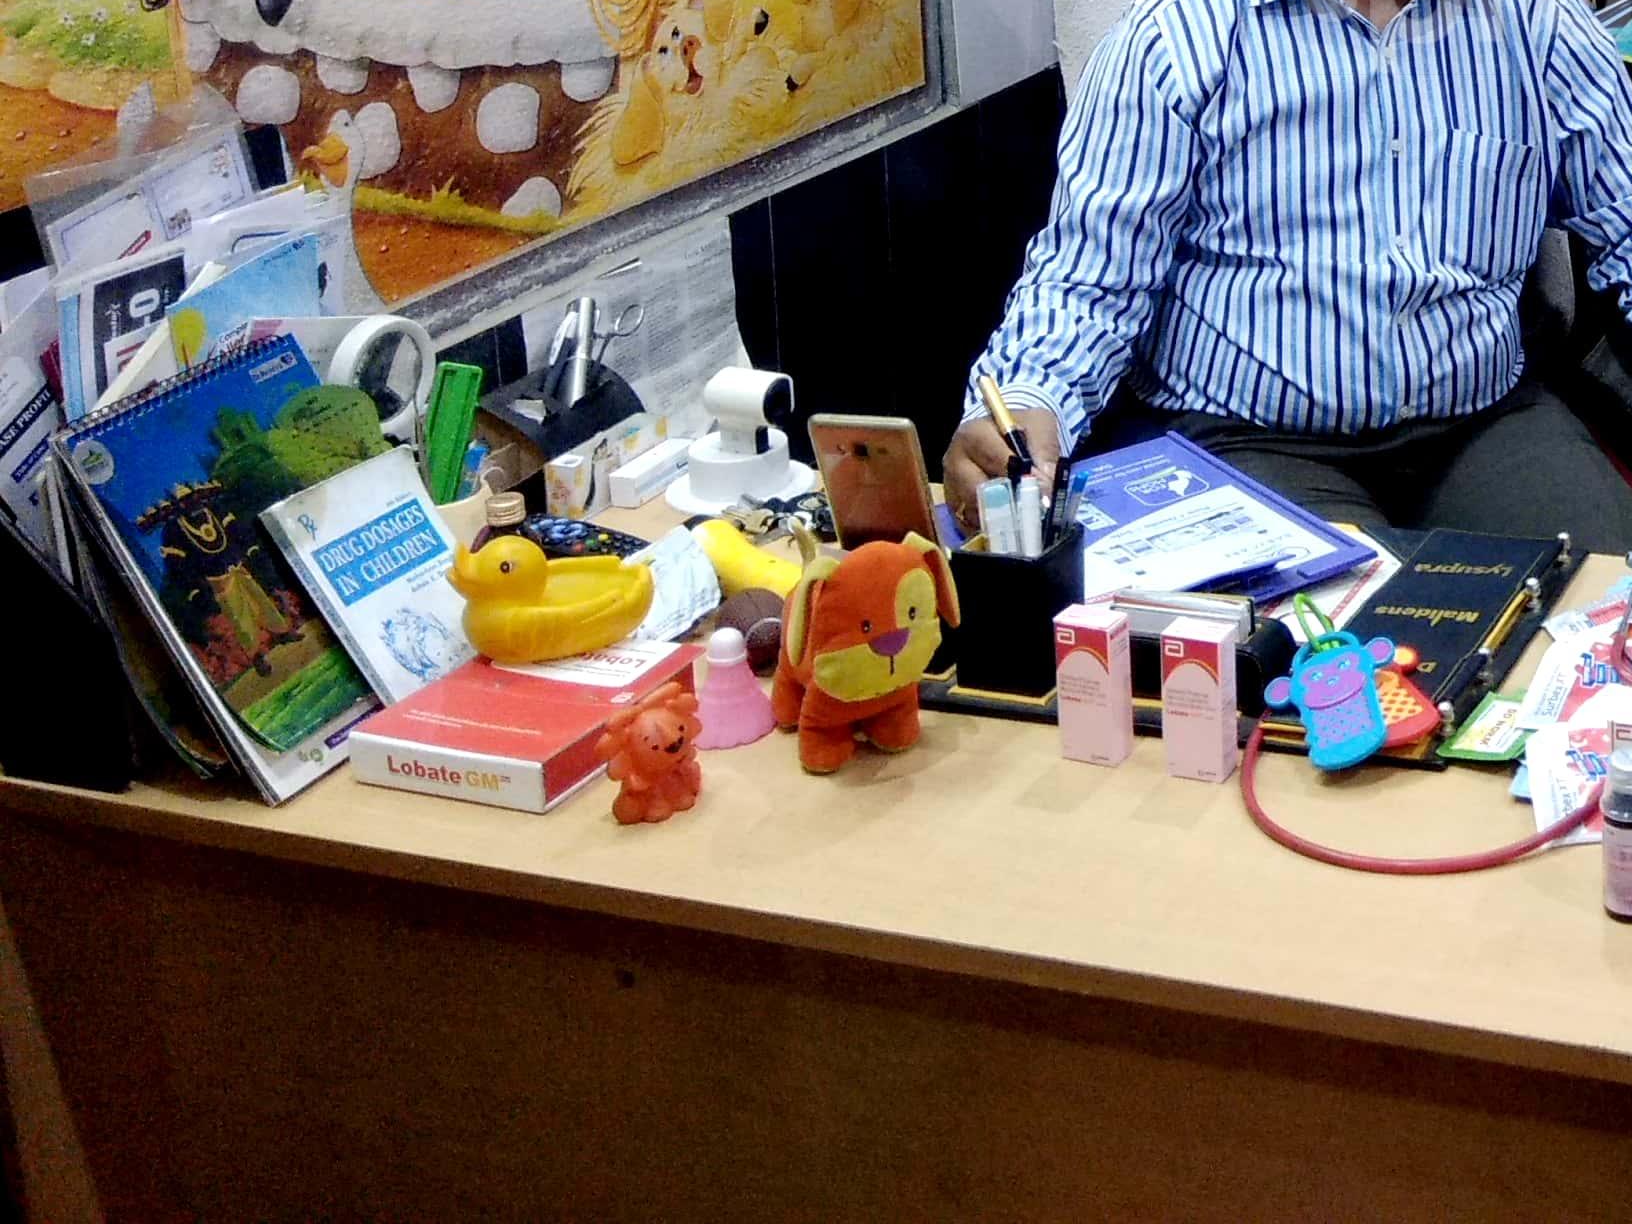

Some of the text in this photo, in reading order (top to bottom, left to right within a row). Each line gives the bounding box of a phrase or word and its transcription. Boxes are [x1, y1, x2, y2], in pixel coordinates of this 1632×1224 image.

[319, 504, 425, 573] DRUG DOSAGES
[335, 571, 361, 597] IN
[360, 528, 438, 583] CHILDREN
[1413, 562, 1516, 577] Lysupra
[1375, 604, 1482, 627] Malidens
[387, 754, 500, 792] Lobate GM
